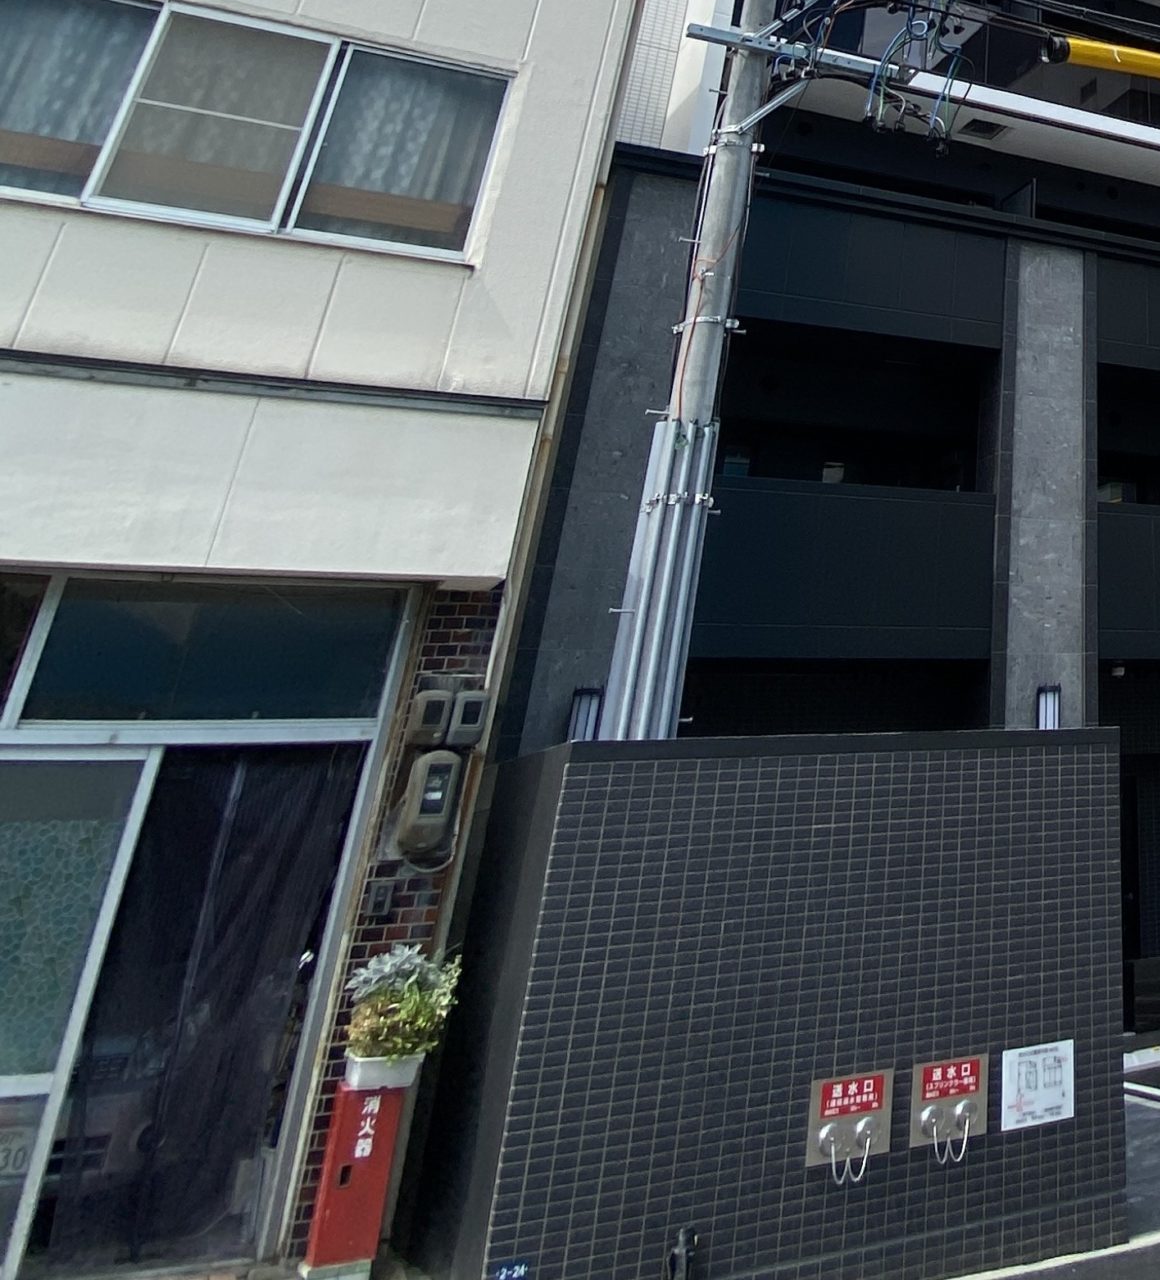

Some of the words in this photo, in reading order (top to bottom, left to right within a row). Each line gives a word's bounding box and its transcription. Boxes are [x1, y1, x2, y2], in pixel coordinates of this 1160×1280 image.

[932, 1063, 971, 1081] 送水口
[832, 1079, 874, 1098] 送水口
